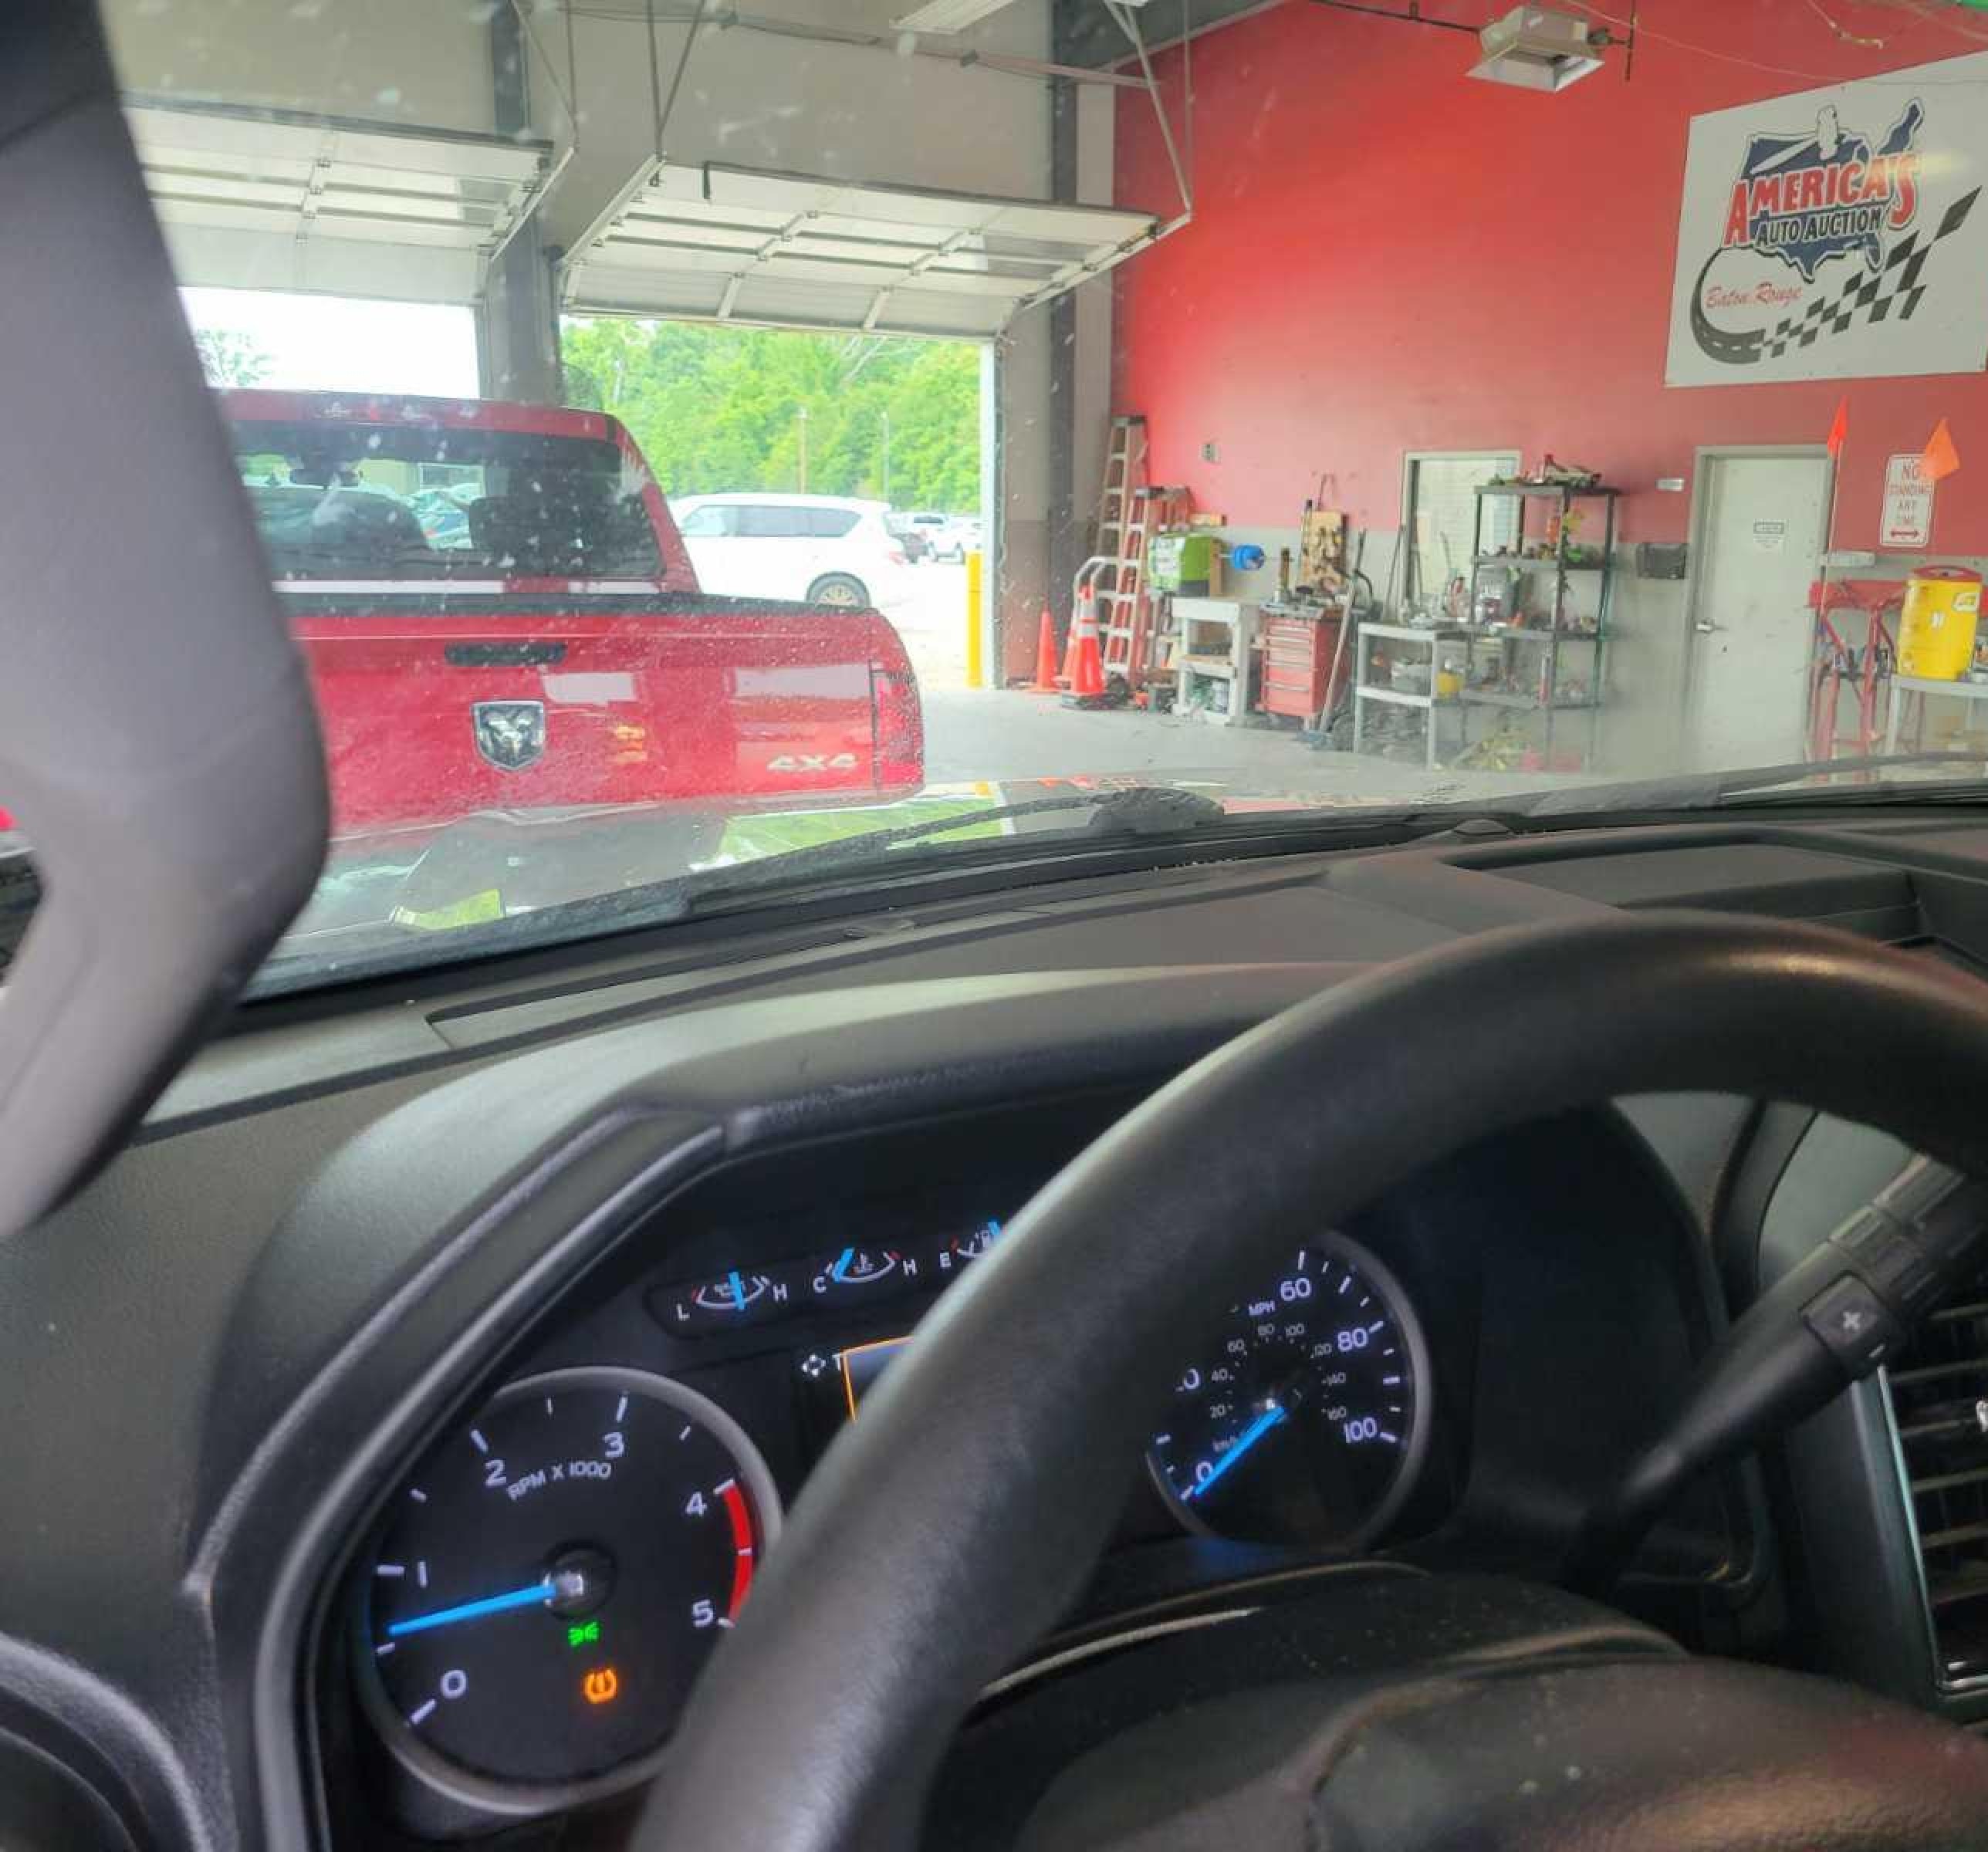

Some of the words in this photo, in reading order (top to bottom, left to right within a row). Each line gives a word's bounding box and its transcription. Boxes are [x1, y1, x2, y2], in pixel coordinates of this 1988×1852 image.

[1722, 154, 1918, 245] AMERICA'S
[1756, 219, 1800, 247] AUTO
[1803, 205, 1884, 239] AUCTION
[903, 1259, 917, 1276] H
[939, 1252, 952, 1268] E
[773, 1284, 788, 1302] H
[813, 1277, 826, 1294] C
[1280, 1277, 1311, 1302] 60
[677, 1305, 690, 1321] L
[1248, 1300, 1276, 1316] MPH
[1285, 1323, 1305, 1337] 100
[1337, 1327, 1368, 1351] 80
[1227, 1339, 1246, 1353] 60
[1211, 1368, 1229, 1382] 40
[1327, 1372, 1347, 1387] 140
[1344, 1418, 1378, 1444] 100
[604, 1431, 625, 1458] 3
[485, 1459, 507, 1487] 2
[507, 1470, 546, 1502] RPM
[569, 1461, 612, 1479] 1000
[1195, 1461, 1215, 1482] 0
[685, 1492, 708, 1516] 4
[417, 1561, 428, 1588] 1
[691, 1599, 715, 1627] 5
[441, 1668, 468, 1699] 0
